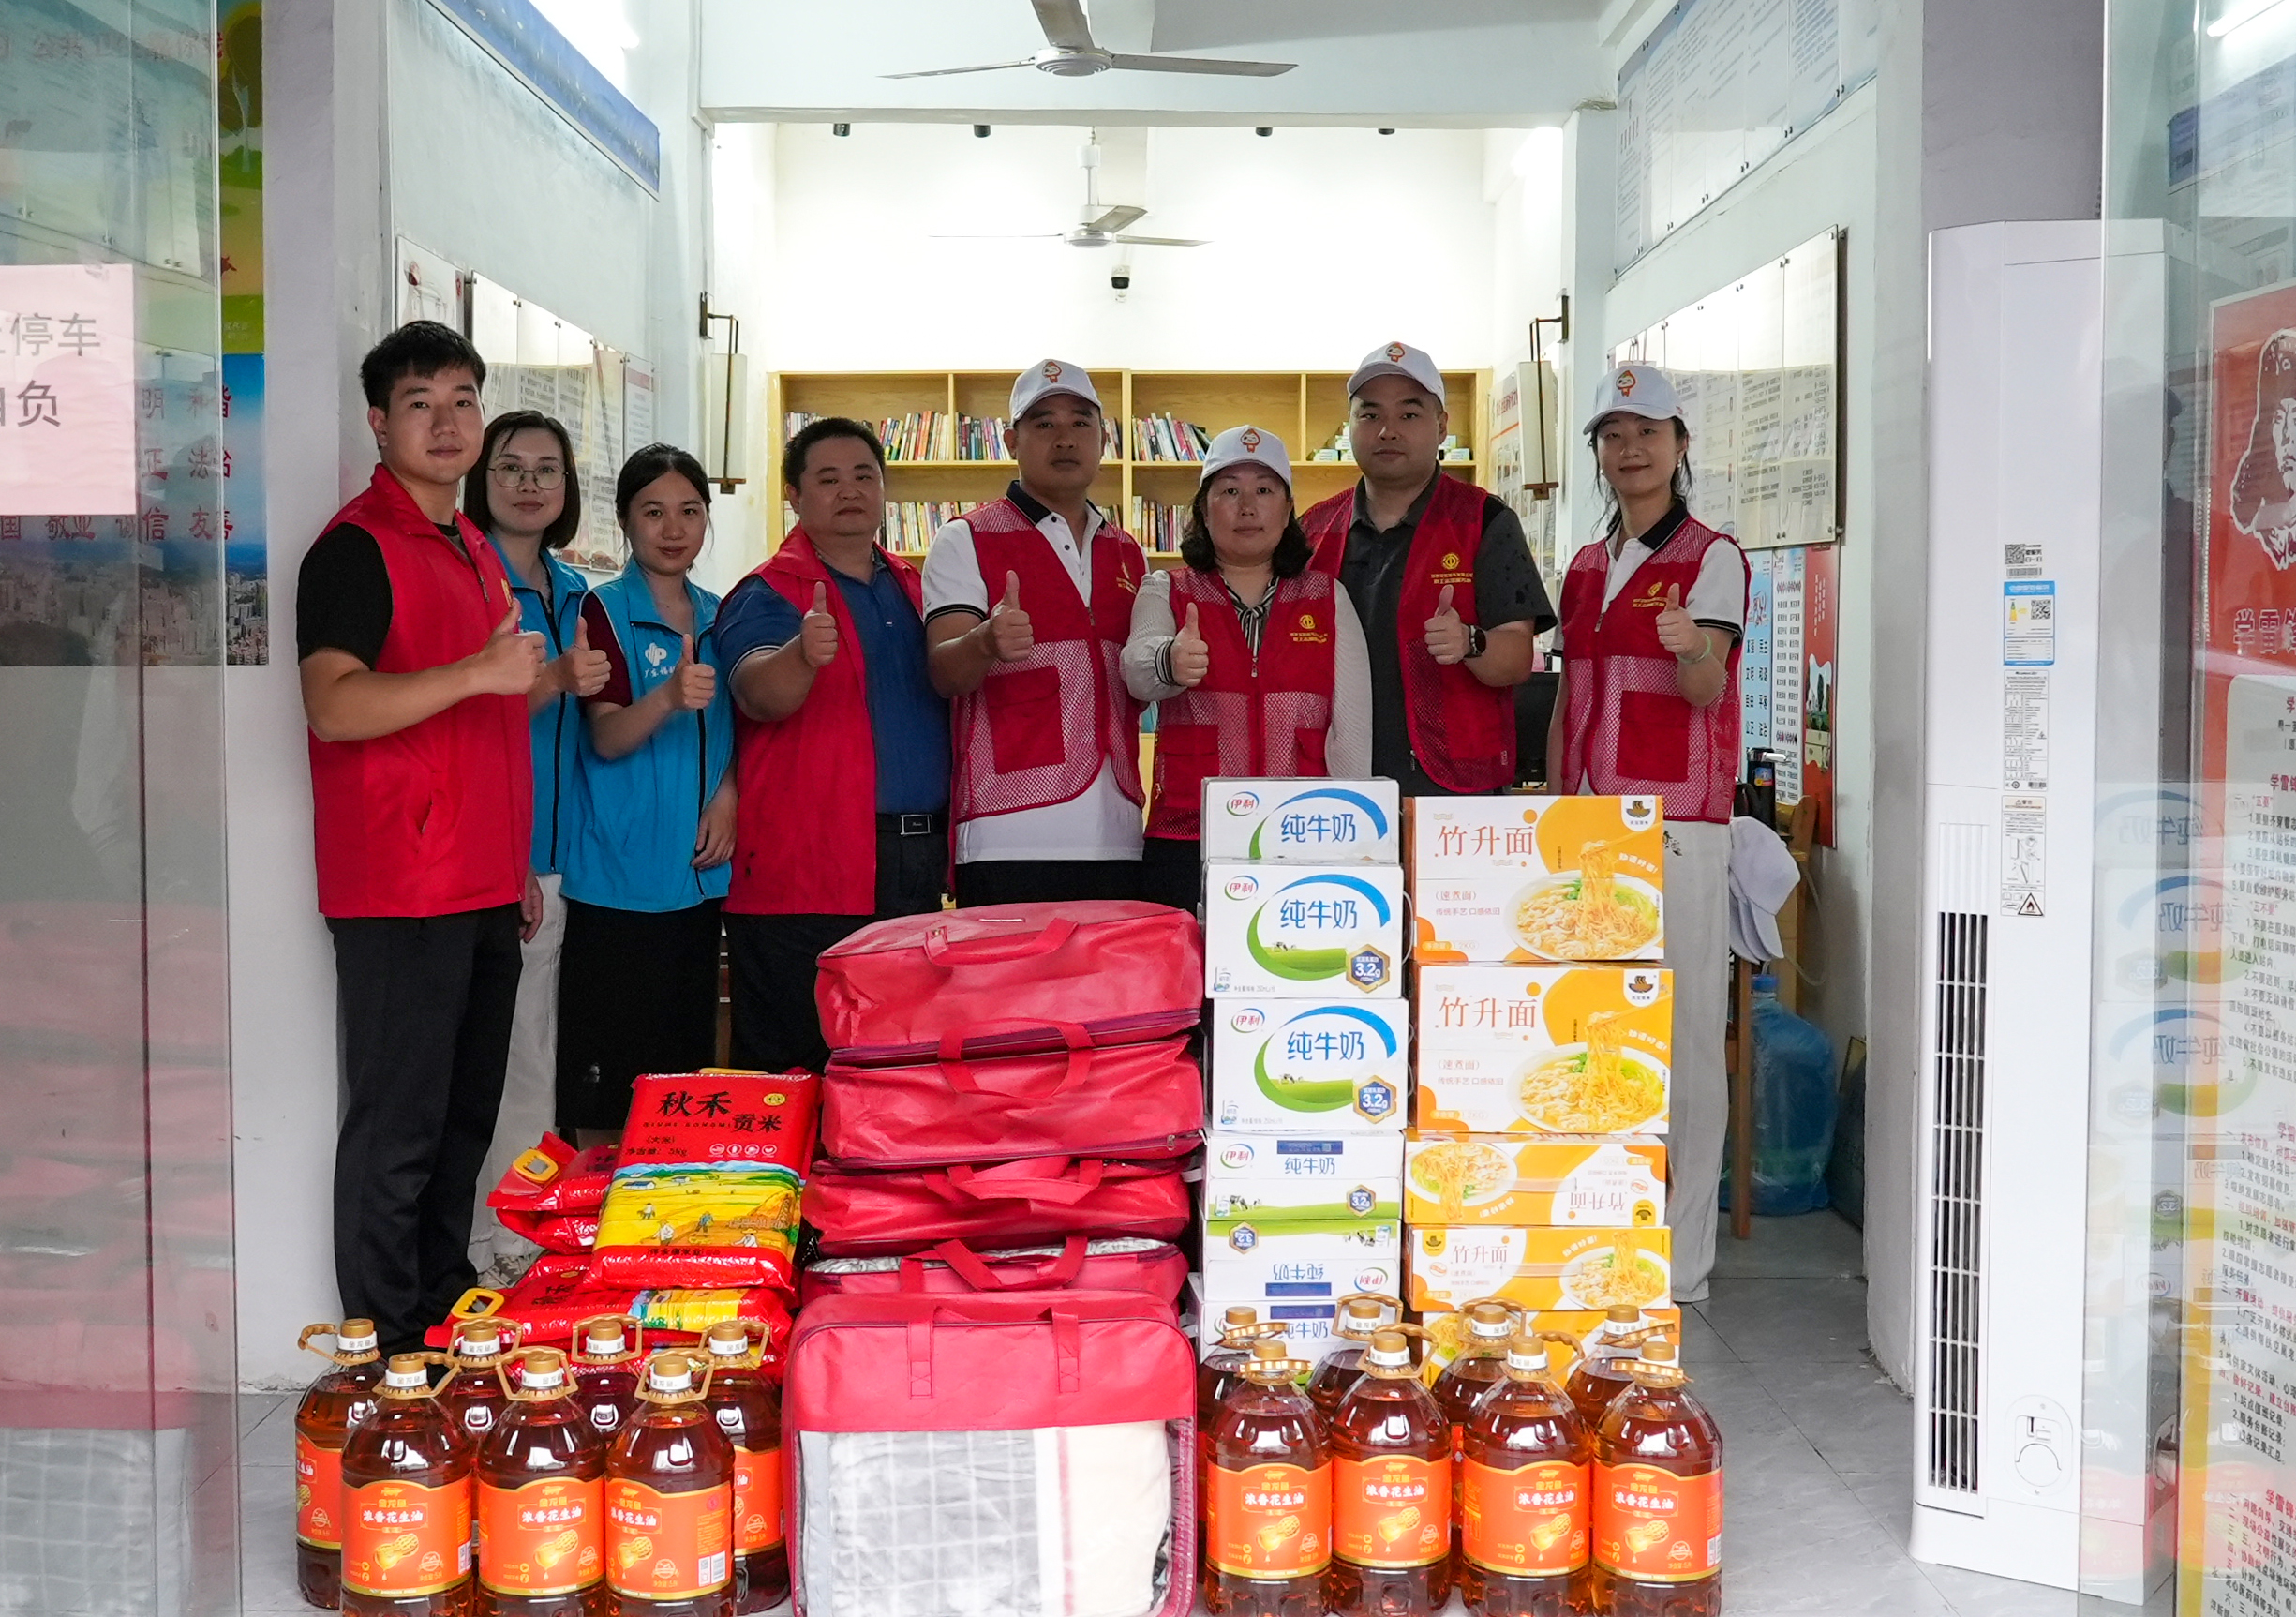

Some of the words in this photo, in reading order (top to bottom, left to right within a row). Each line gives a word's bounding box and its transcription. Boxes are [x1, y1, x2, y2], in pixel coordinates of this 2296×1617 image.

[0, 312, 100, 356] 停车
[0, 380, 60, 427] 负
[1231, 799, 1254, 809] 伊利
[1281, 814, 1356, 842] 纯牛奶
[1438, 826, 1534, 856] 竹升面
[1229, 882, 1253, 892] 伊利
[1280, 899, 1357, 929] 纯牛奶
[1355, 963, 1380, 978] 3.2g
[1236, 1015, 1260, 1026] 伊利
[1439, 996, 1537, 1028] 竹升面
[1287, 1031, 1364, 1060] 纯牛奶
[657, 1091, 732, 1118] 秋禾
[1362, 1094, 1388, 1109] 3.2g
[730, 1114, 782, 1133] 贡米
[1226, 1150, 1248, 1160] 伊利
[1285, 1157, 1335, 1175] 纯牛奶
[1570, 1192, 1625, 1210] 竹升面
[1454, 1245, 1507, 1263] 竹升面
[1274, 1264, 1324, 1280] 纯牛奶
[1245, 1492, 1305, 1506] 浓香花生油
[1366, 1485, 1424, 1498] 浓香花生油
[1518, 1490, 1574, 1505] 浓香花生油
[1615, 1491, 1674, 1509] 浓香花生油
[363, 1510, 423, 1523] 浓香花生油
[522, 1506, 582, 1523] 浓香花生油
